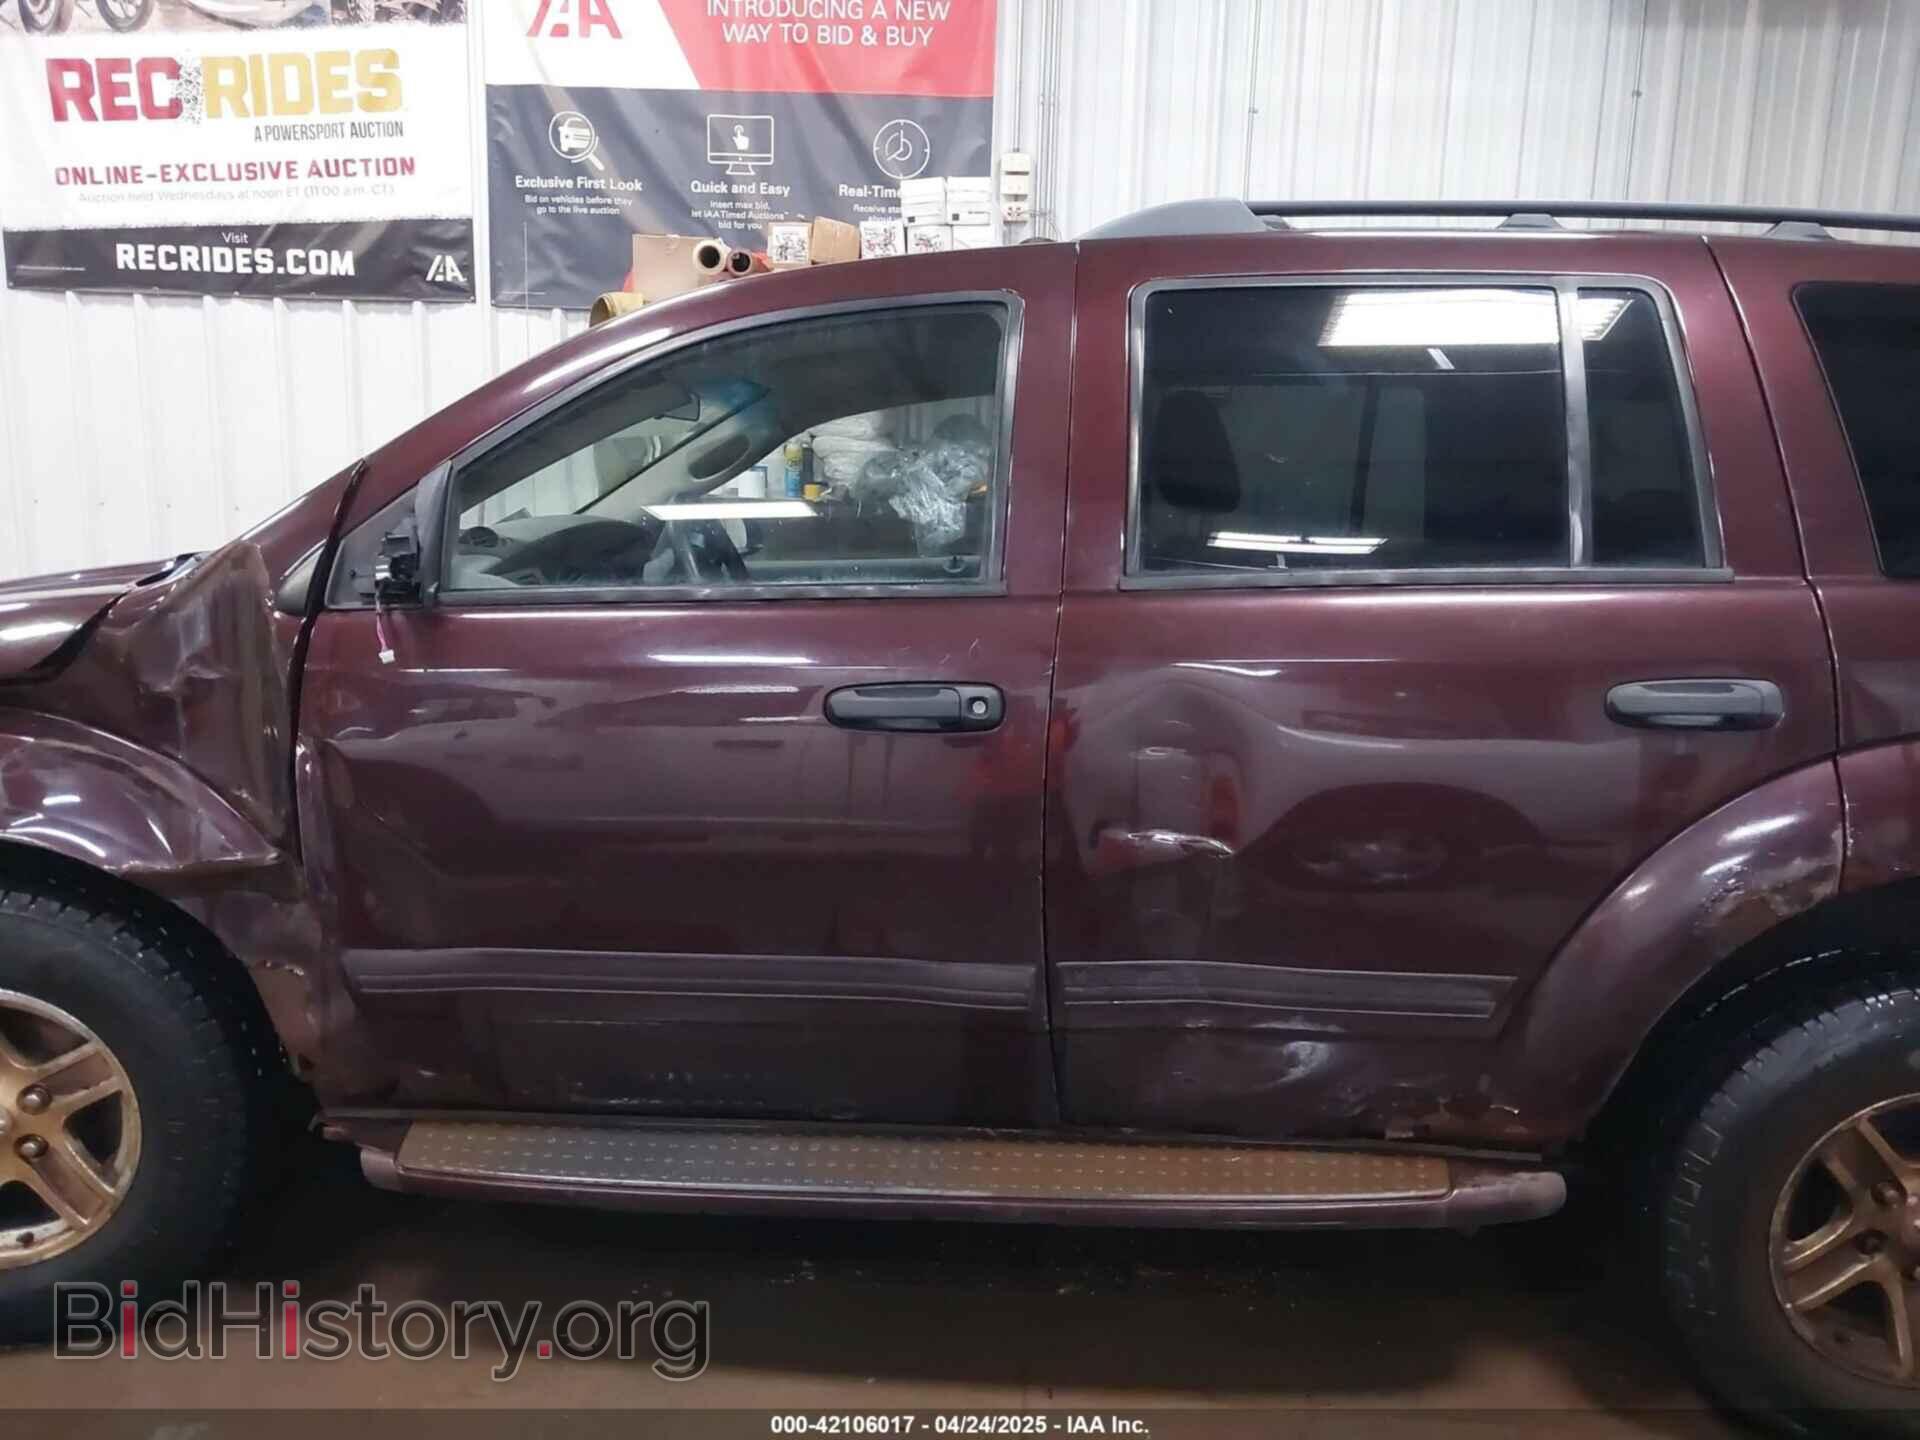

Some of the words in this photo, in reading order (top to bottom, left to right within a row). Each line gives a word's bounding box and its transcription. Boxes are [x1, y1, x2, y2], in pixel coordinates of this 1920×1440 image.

[707, 0, 863, 19] INTRODUCING
[871, 0, 887, 19] A
[896, 1, 950, 20] NEW
[722, 23, 772, 43] WAY
[779, 23, 808, 43] TO
[817, 25, 853, 45] BID
[860, 25, 877, 46] &
[886, 26, 933, 46] BUY
[46, 57, 183, 122] REC
[200, 48, 402, 118] RIDES
[254, 125, 262, 142] A
[265, 122, 345, 142] POWERSPORT
[350, 121, 403, 139] AUCTION
[55, 163, 298, 186] ONLINE-EXCLUSIVE
[308, 157, 415, 178] AUCTION
[515, 175, 574, 189] Exclusive
[576, 176, 606, 190] First
[610, 178, 643, 191] Look
[690, 180, 728, 194] Quick
[731, 181, 756, 194] and
[760, 182, 790, 197] Easy
[524, 194, 538, 204] Bid
[539, 196, 550, 204] on
[551, 195, 584, 205] vehicles
[586, 196, 612, 205] before
[537, 206, 547, 215] go
[558, 205, 571, 214] the
[590, 206, 620, 215] auction
[718, 220, 732, 229] bid
[734, 221, 745, 229] for
[222, 231, 248, 244] Visit
[116, 243, 355, 276] RECRIDES.COM
